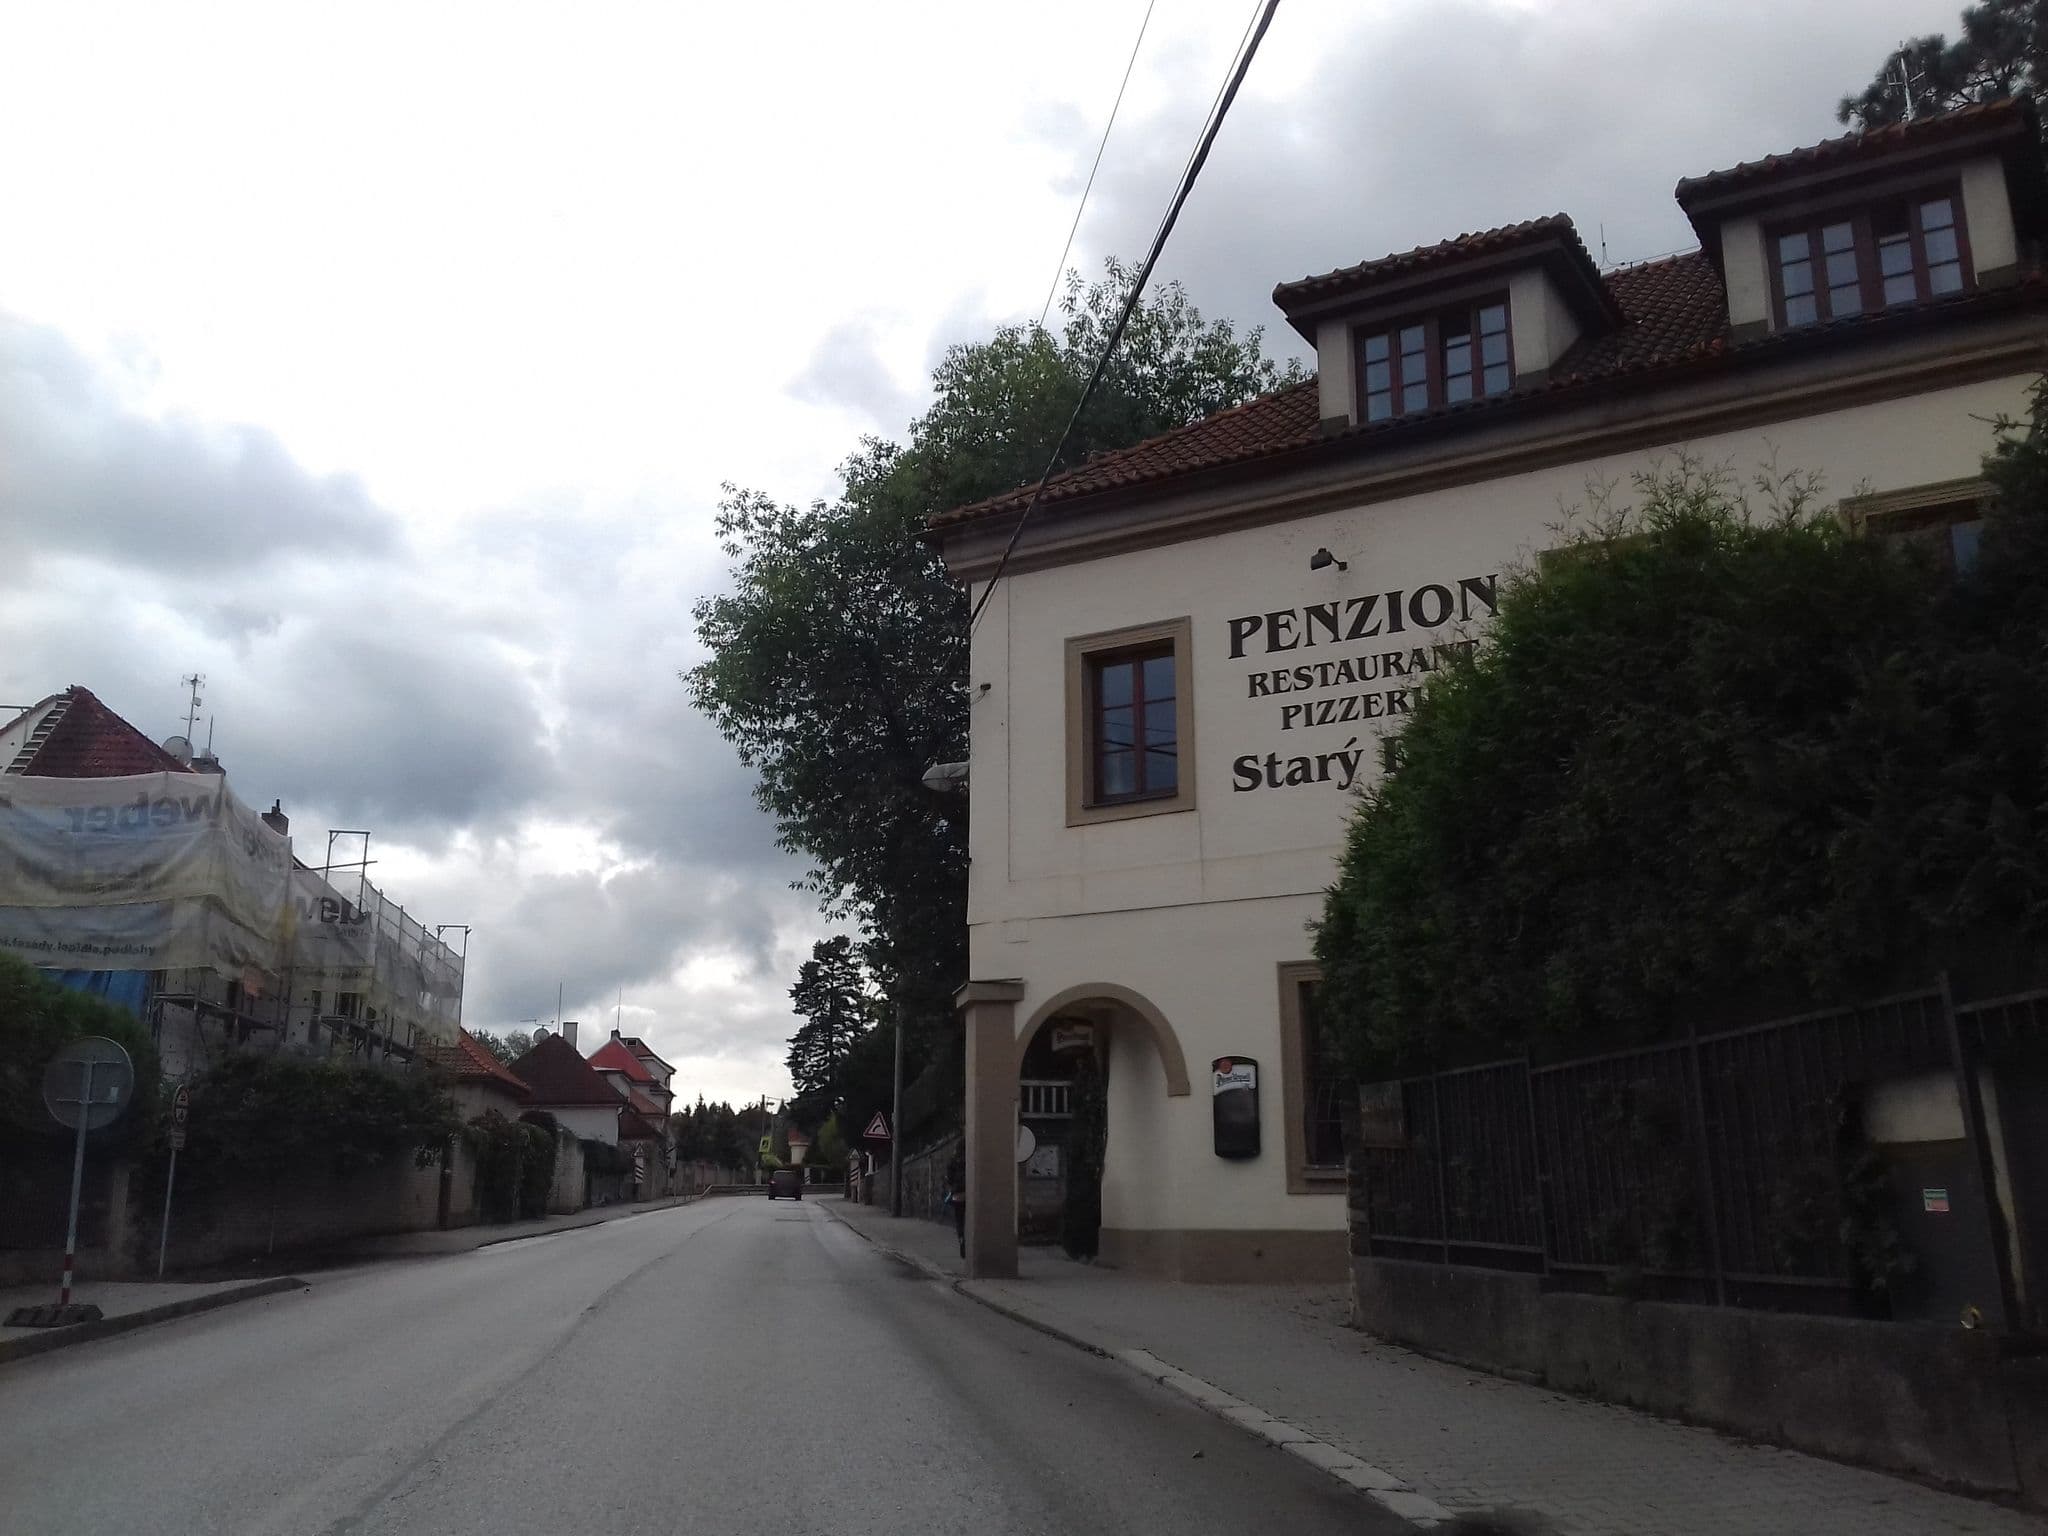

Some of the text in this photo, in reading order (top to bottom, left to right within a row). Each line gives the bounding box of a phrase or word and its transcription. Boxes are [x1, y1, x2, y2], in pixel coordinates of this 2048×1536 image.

[1227, 573, 1501, 660] PENZION
[1280, 686, 1432, 730] PIZZERI
[1232, 737, 1364, 792] Starý
